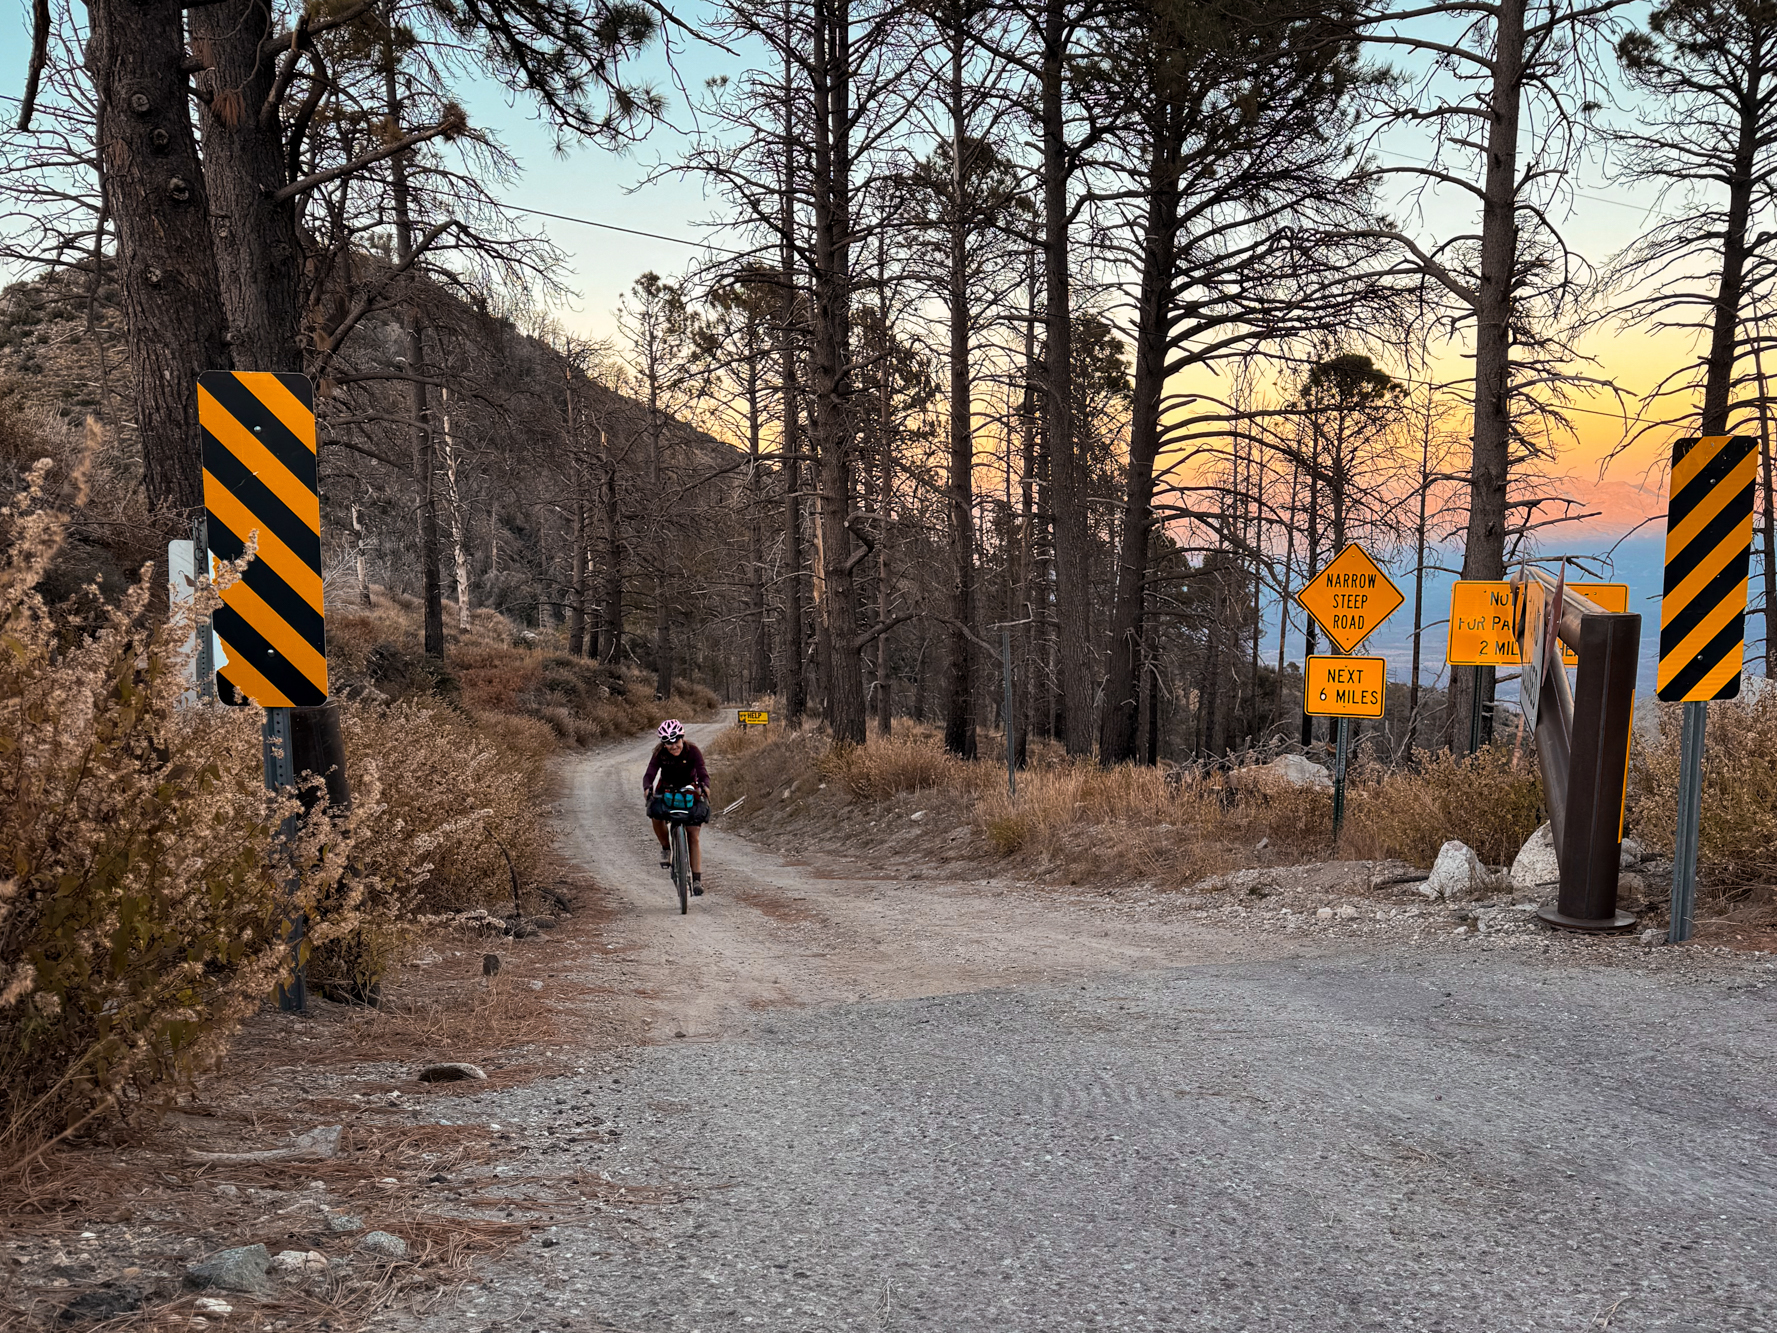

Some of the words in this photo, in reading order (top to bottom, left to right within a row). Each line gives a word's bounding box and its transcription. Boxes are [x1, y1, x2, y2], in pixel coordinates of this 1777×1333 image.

[1326, 573, 1377, 589] NARROW
[1332, 594, 1368, 609] STEEP
[1333, 615, 1365, 630] ROAD
[1479, 640, 1489, 656] 2
[1495, 640, 1519, 656] MIL
[1327, 669, 1364, 684] NEXT
[1319, 687, 1328, 702] 6
[1335, 689, 1378, 705] MILES
